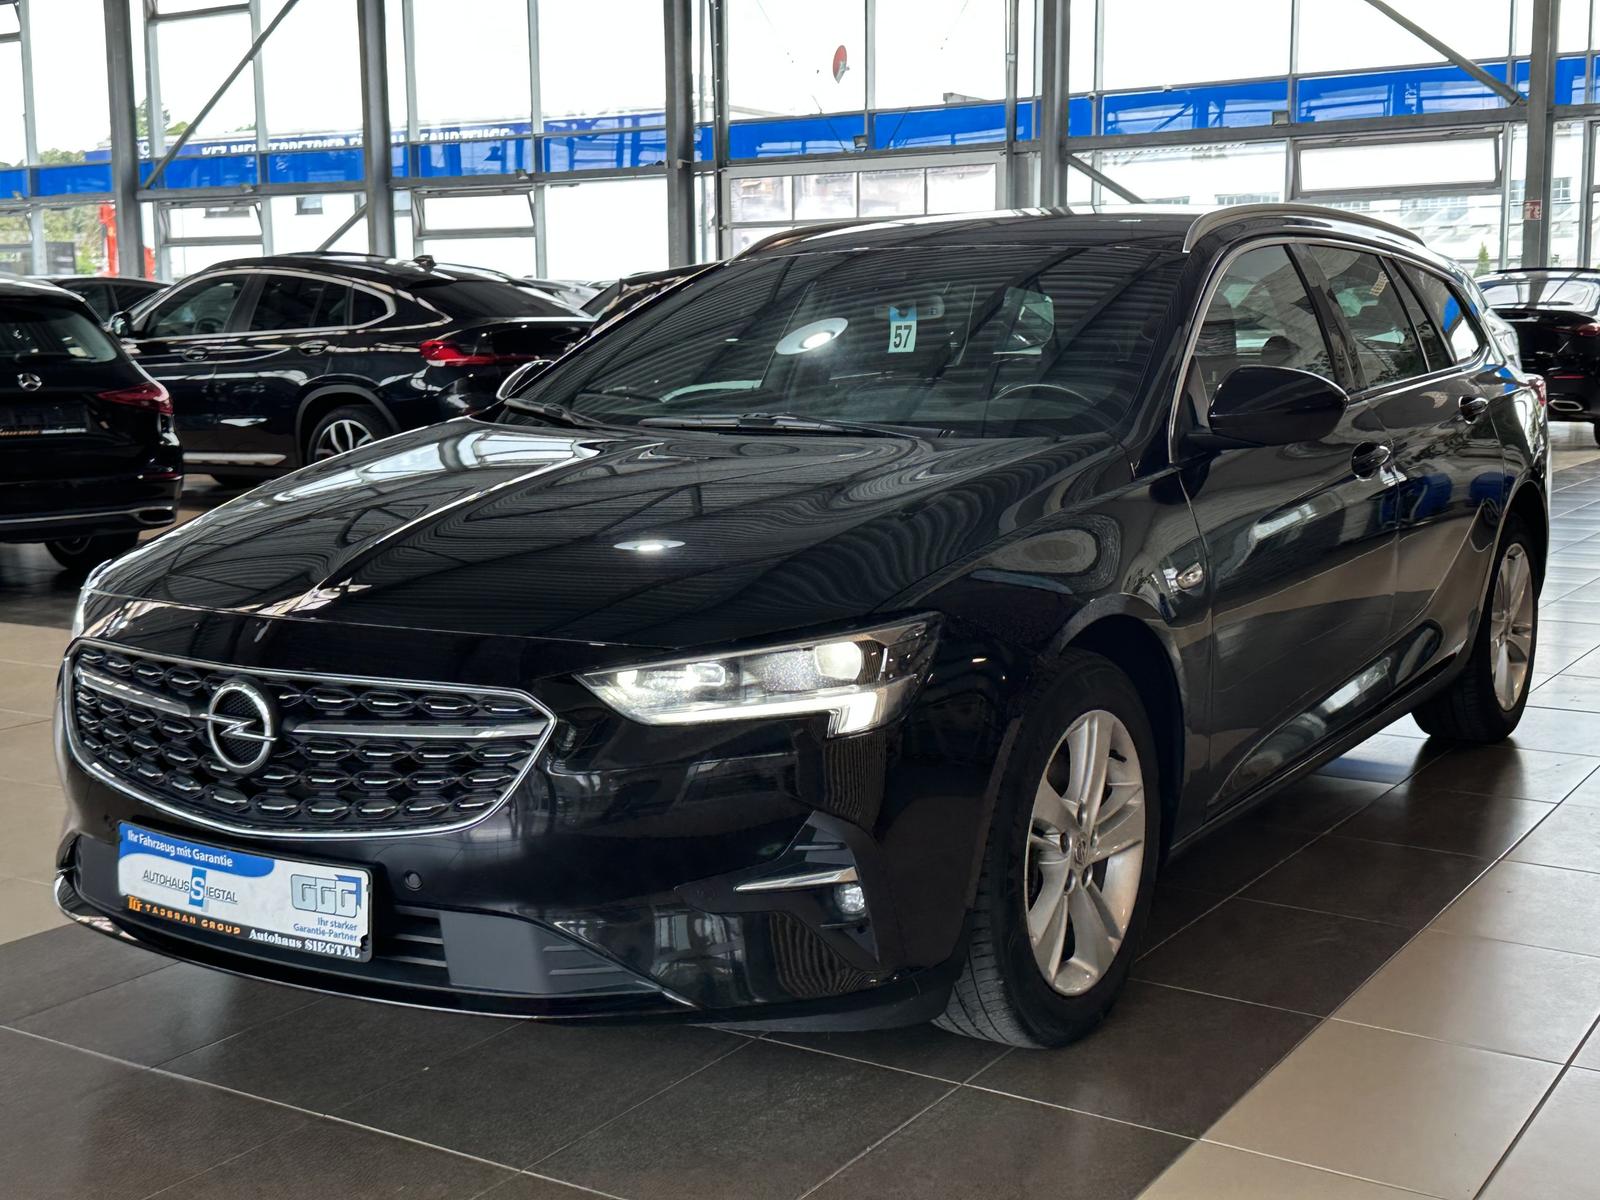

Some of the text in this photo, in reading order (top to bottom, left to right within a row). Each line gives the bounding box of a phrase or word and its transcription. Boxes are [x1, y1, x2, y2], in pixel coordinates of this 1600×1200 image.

[894, 325, 912, 349] 57
[127, 829, 233, 867] Ihr Fahrzeug mit Garantie
[143, 869, 190, 892] AUTOHAUS
[201, 919, 241, 935] GROUP
[293, 923, 358, 942] Garantie-Partner
[317, 917, 358, 931] Ihr starker
[249, 929, 360, 959] Autohaus SIEGTAL
